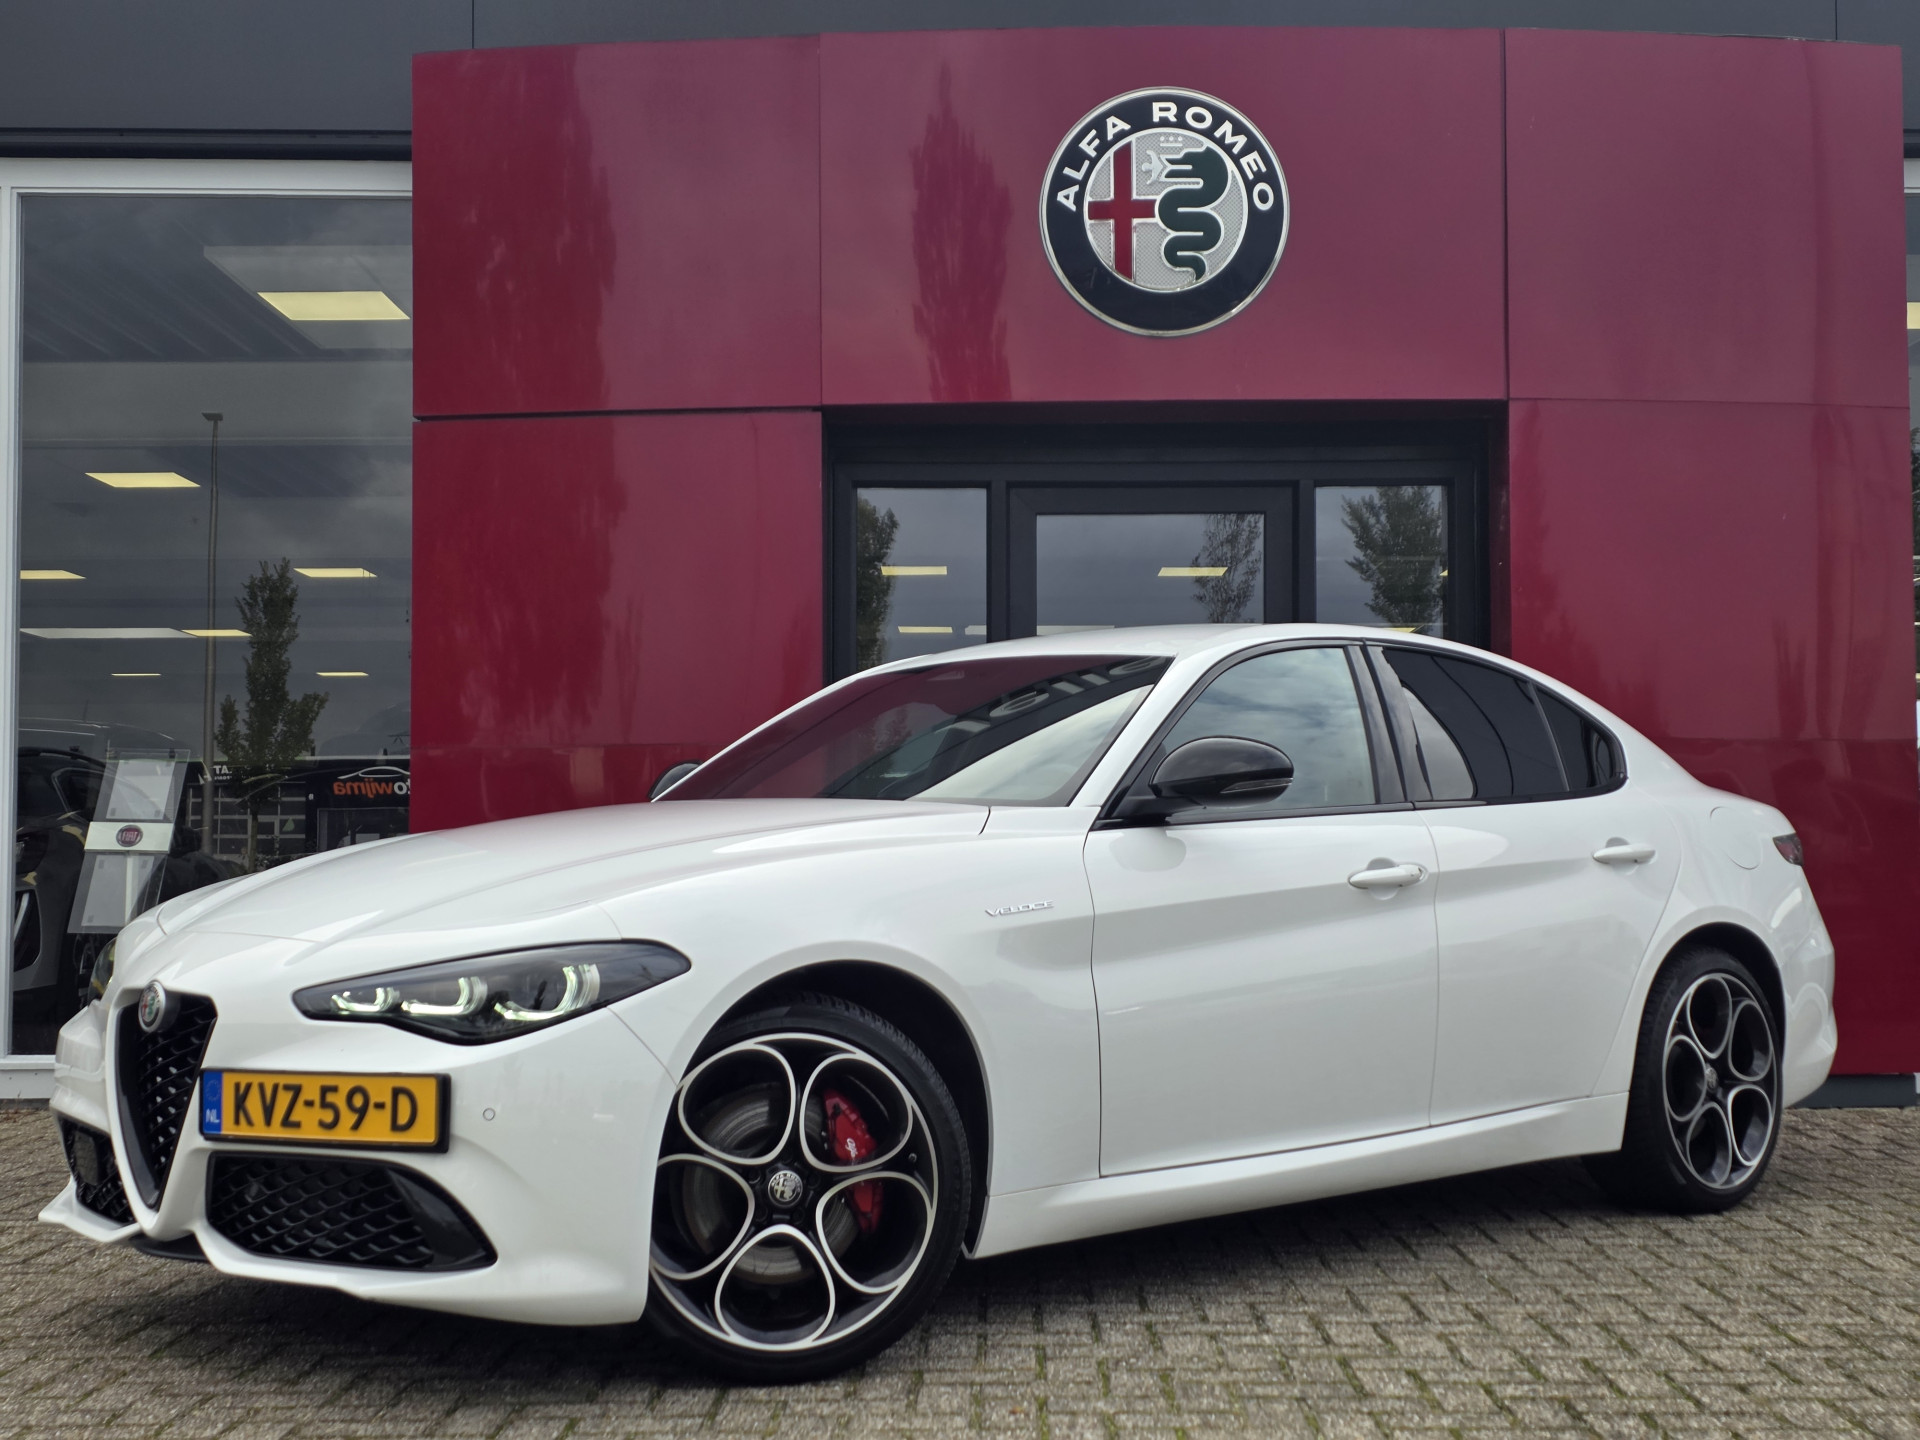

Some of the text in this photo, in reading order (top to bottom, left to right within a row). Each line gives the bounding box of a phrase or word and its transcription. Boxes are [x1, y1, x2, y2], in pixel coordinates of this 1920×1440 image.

[1056, 101, 1274, 212] ALFA ROMEO
[984, 899, 1055, 917] VELOCE
[205, 1108, 220, 1123] NL
[233, 1082, 418, 1132] KVZ-59-D
